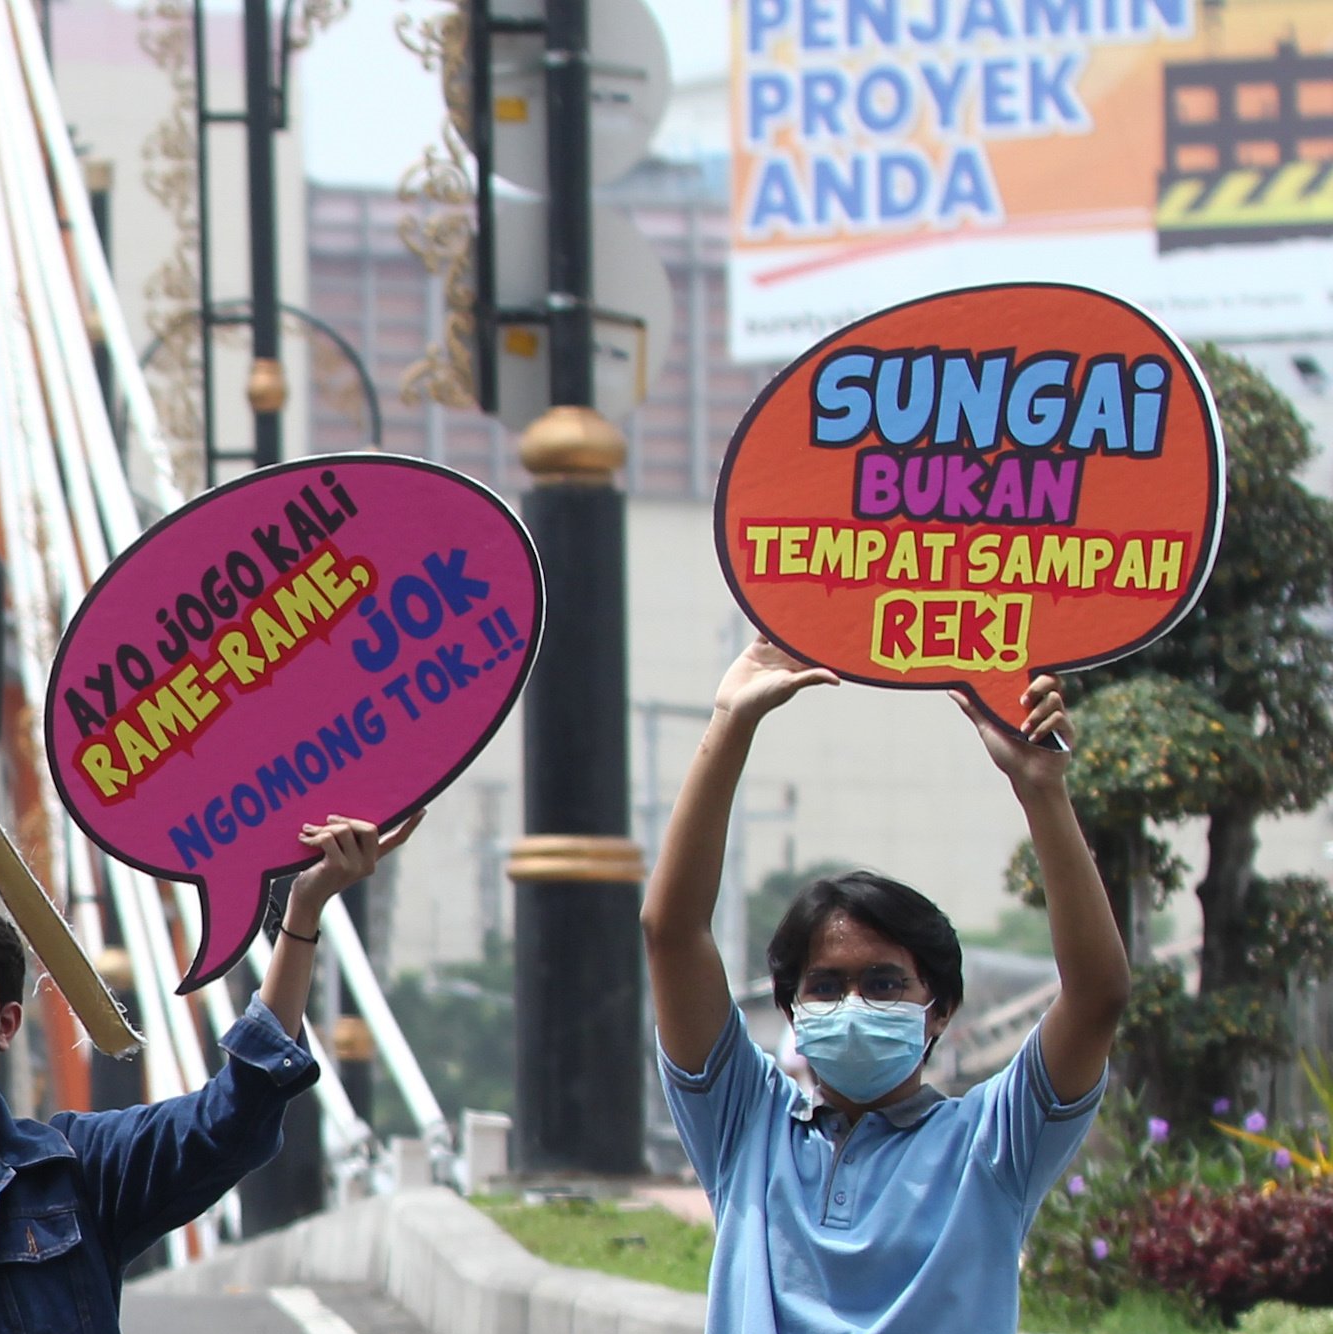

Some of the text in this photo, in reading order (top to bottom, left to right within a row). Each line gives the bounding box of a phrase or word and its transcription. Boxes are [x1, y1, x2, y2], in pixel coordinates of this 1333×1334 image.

[749, 52, 1086, 141] PROYEK
[749, 146, 1001, 229] ANDA
[858, 453, 1080, 523] BUKAN
[746, 524, 1185, 592] TEMPAT SAMPAH
[879, 598, 1021, 662] REK!
[62, 644, 155, 738] AYO
[80, 551, 371, 799] RAME-RAME,
[167, 701, 387, 871] NGOMONG
